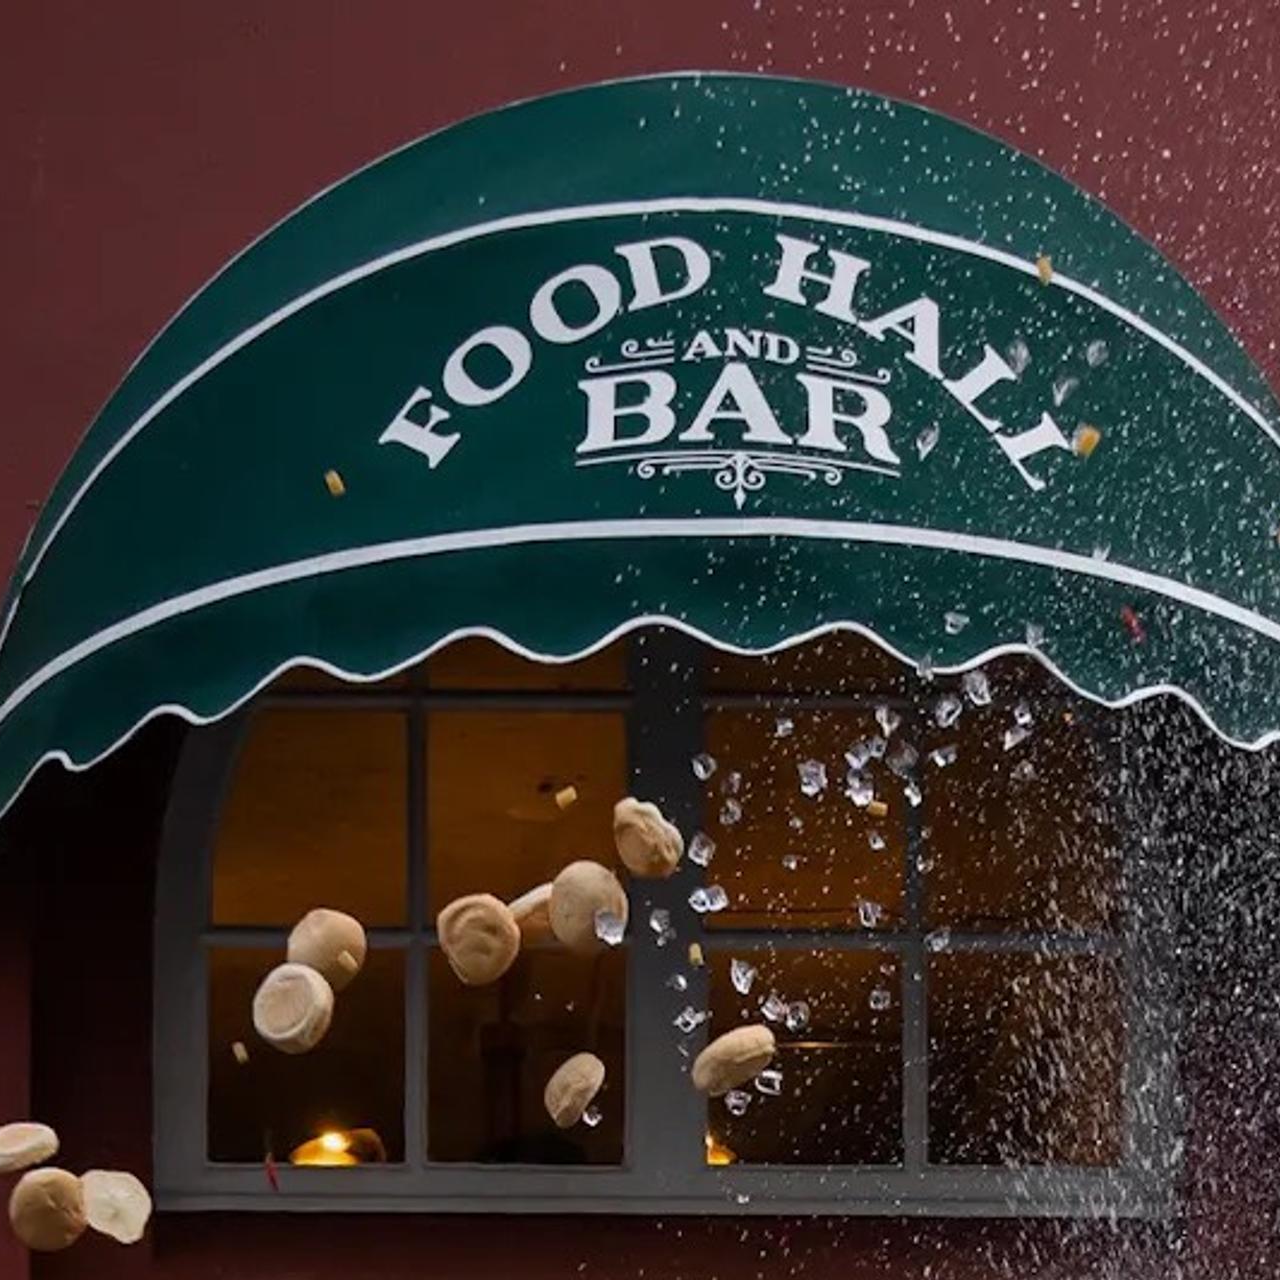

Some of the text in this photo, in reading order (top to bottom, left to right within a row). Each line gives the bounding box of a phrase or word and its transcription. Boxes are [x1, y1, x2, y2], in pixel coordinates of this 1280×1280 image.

[378, 233, 1076, 493] FOOD HALL
[682, 329, 801, 364] AND
[575, 363, 900, 465] BAR
